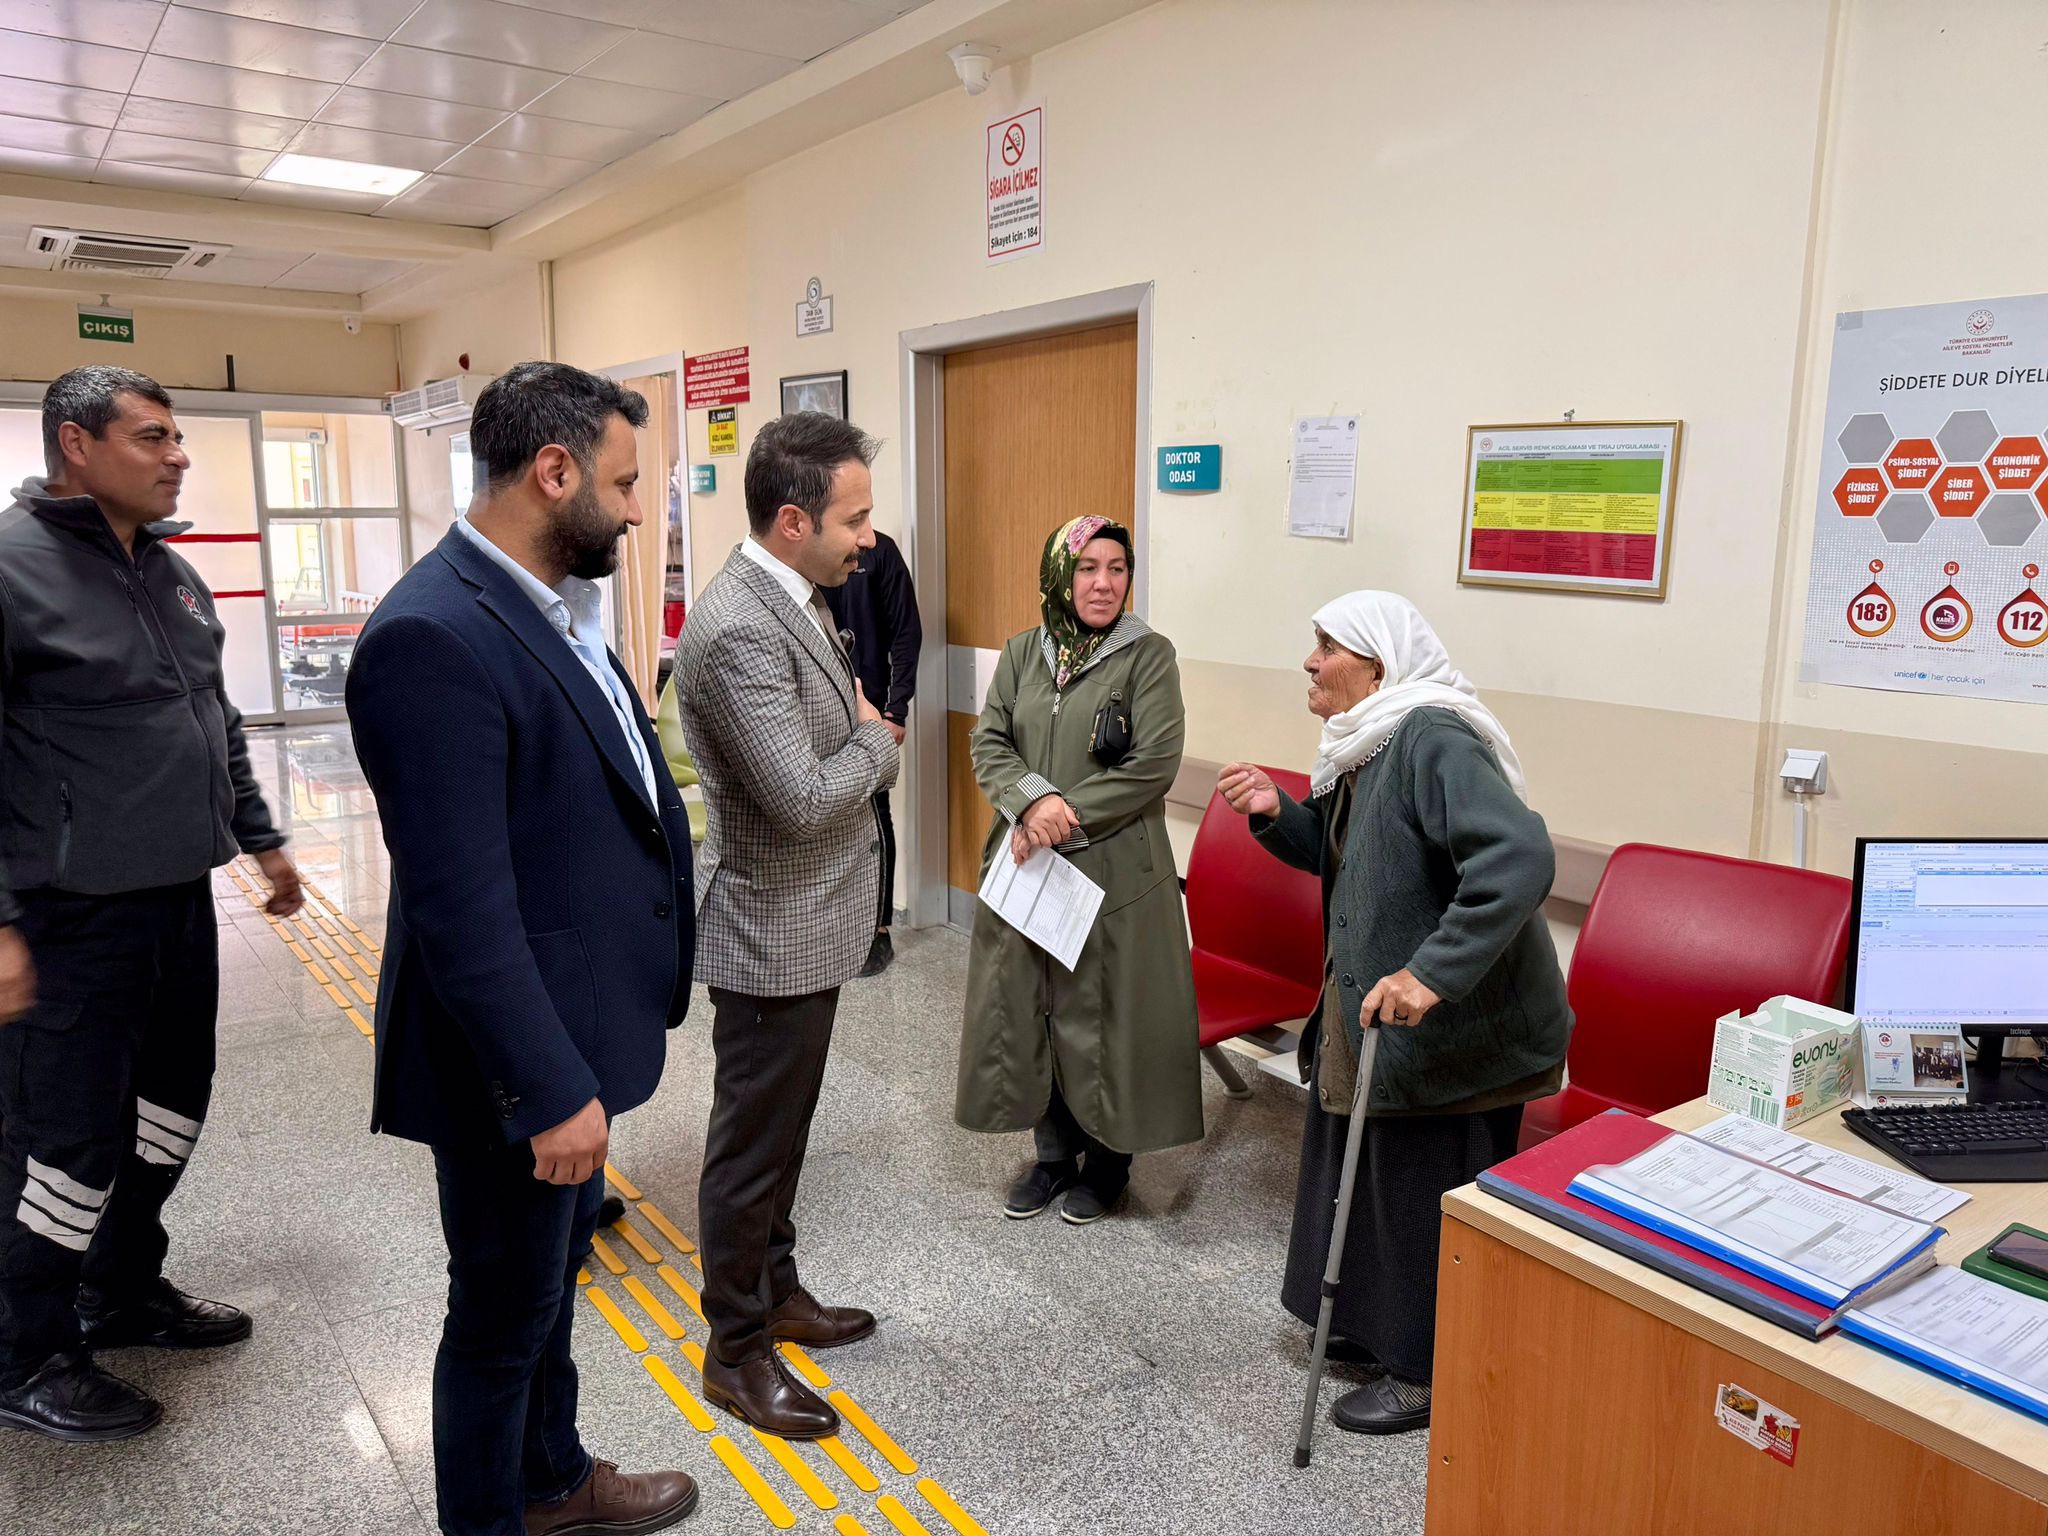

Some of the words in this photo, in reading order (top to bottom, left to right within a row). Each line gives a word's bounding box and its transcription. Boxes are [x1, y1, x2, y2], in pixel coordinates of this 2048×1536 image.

[990, 175, 1012, 200] SİGARA
[1012, 167, 1038, 196] İÇİLMEZ
[991, 234, 1011, 248] Şikayet
[1012, 230, 1023, 242] için
[1027, 226, 1038, 238] 184
[83, 322, 130, 337] ÇIKIŞ
[1879, 374, 1946, 395] ŞİDDETE
[1952, 372, 1989, 387] DUR
[1166, 452, 1200, 464] DOKTOR
[1888, 457, 1939, 466] PSİKO-SOSYAL
[1992, 454, 2040, 465] EKONOMİK
[1169, 470, 1195, 482] ODASI
[1898, 468, 1928, 479] ŞİDDET
[1999, 467, 2032, 480] ŞİDDET
[1847, 482, 1879, 492] FİZİKSEL
[1947, 478, 1973, 488] SİBER
[1848, 494, 1876, 504] ŞİDDET
[1943, 490, 1974, 502] ŞİDDET
[1855, 603, 1888, 622] 183
[2010, 611, 2043, 631] 112
[1894, 670, 1917, 678] unicef
[1946, 676, 1970, 684] çocuk
[1972, 677, 1985, 685] için
[1793, 1037, 1838, 1068] evony
